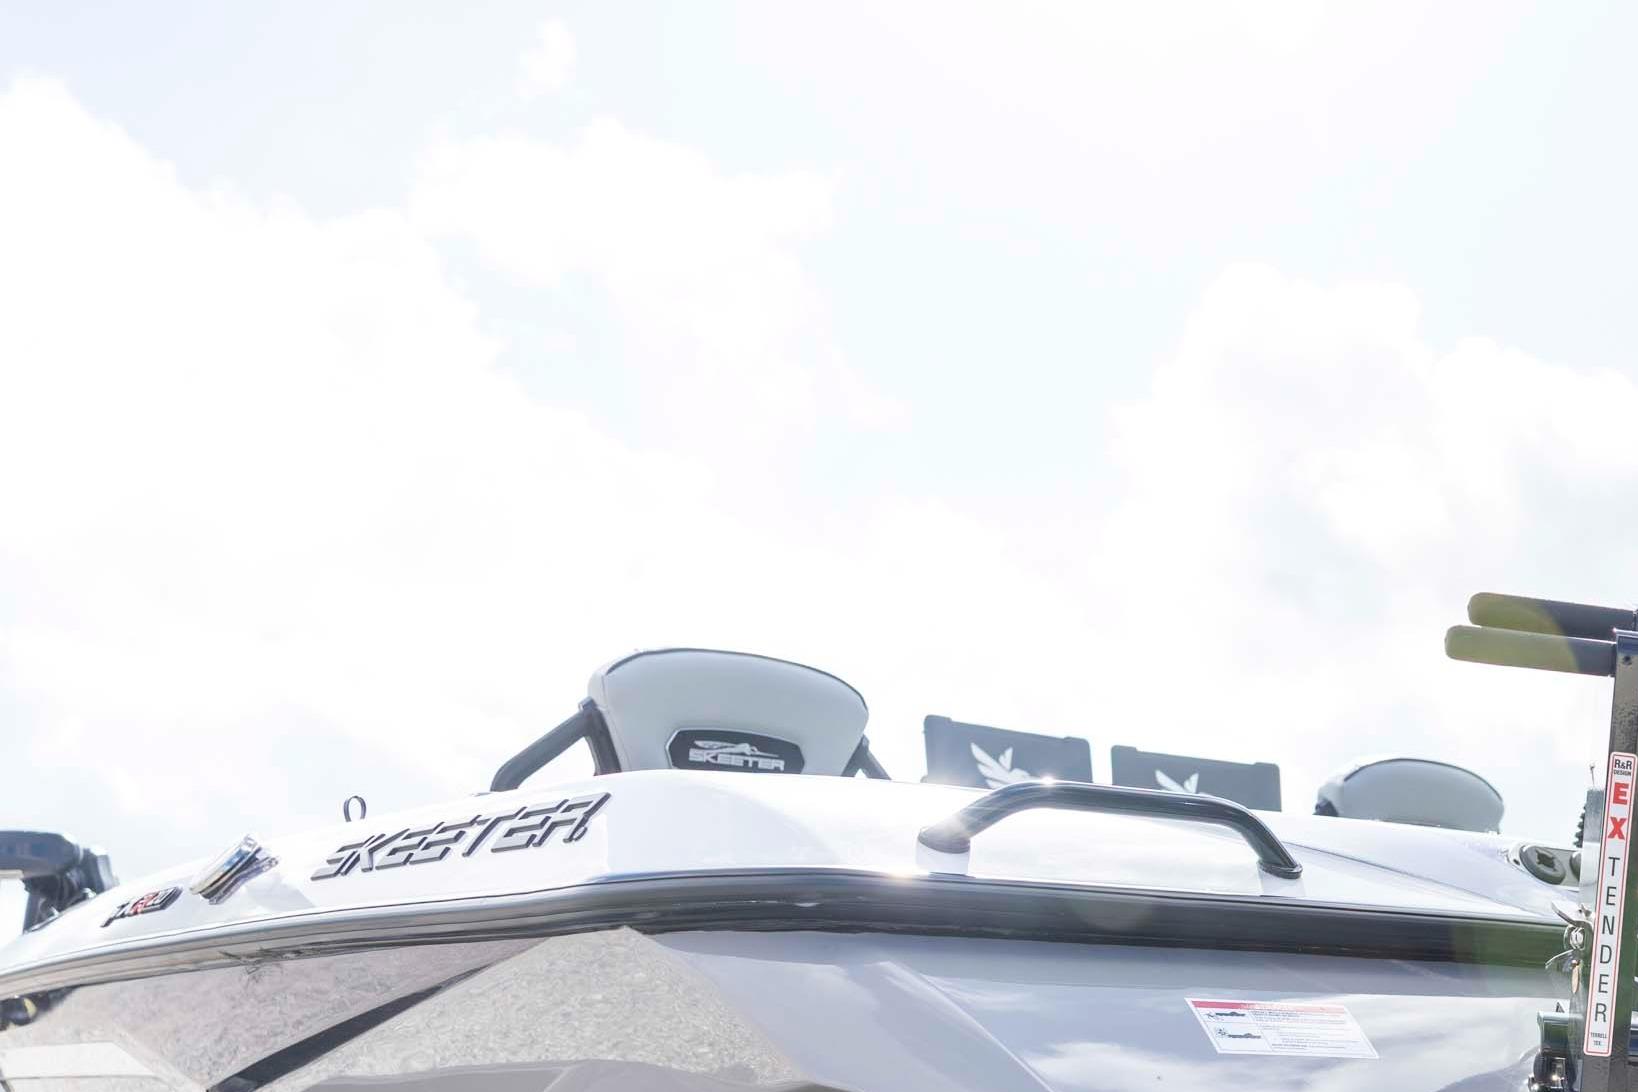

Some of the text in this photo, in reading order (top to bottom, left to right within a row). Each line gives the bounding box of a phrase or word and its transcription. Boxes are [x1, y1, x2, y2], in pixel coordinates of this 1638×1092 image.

[688, 748, 785, 771] SKEETER
[1614, 759, 1633, 770] R&R
[310, 791, 612, 881] SKEETER
